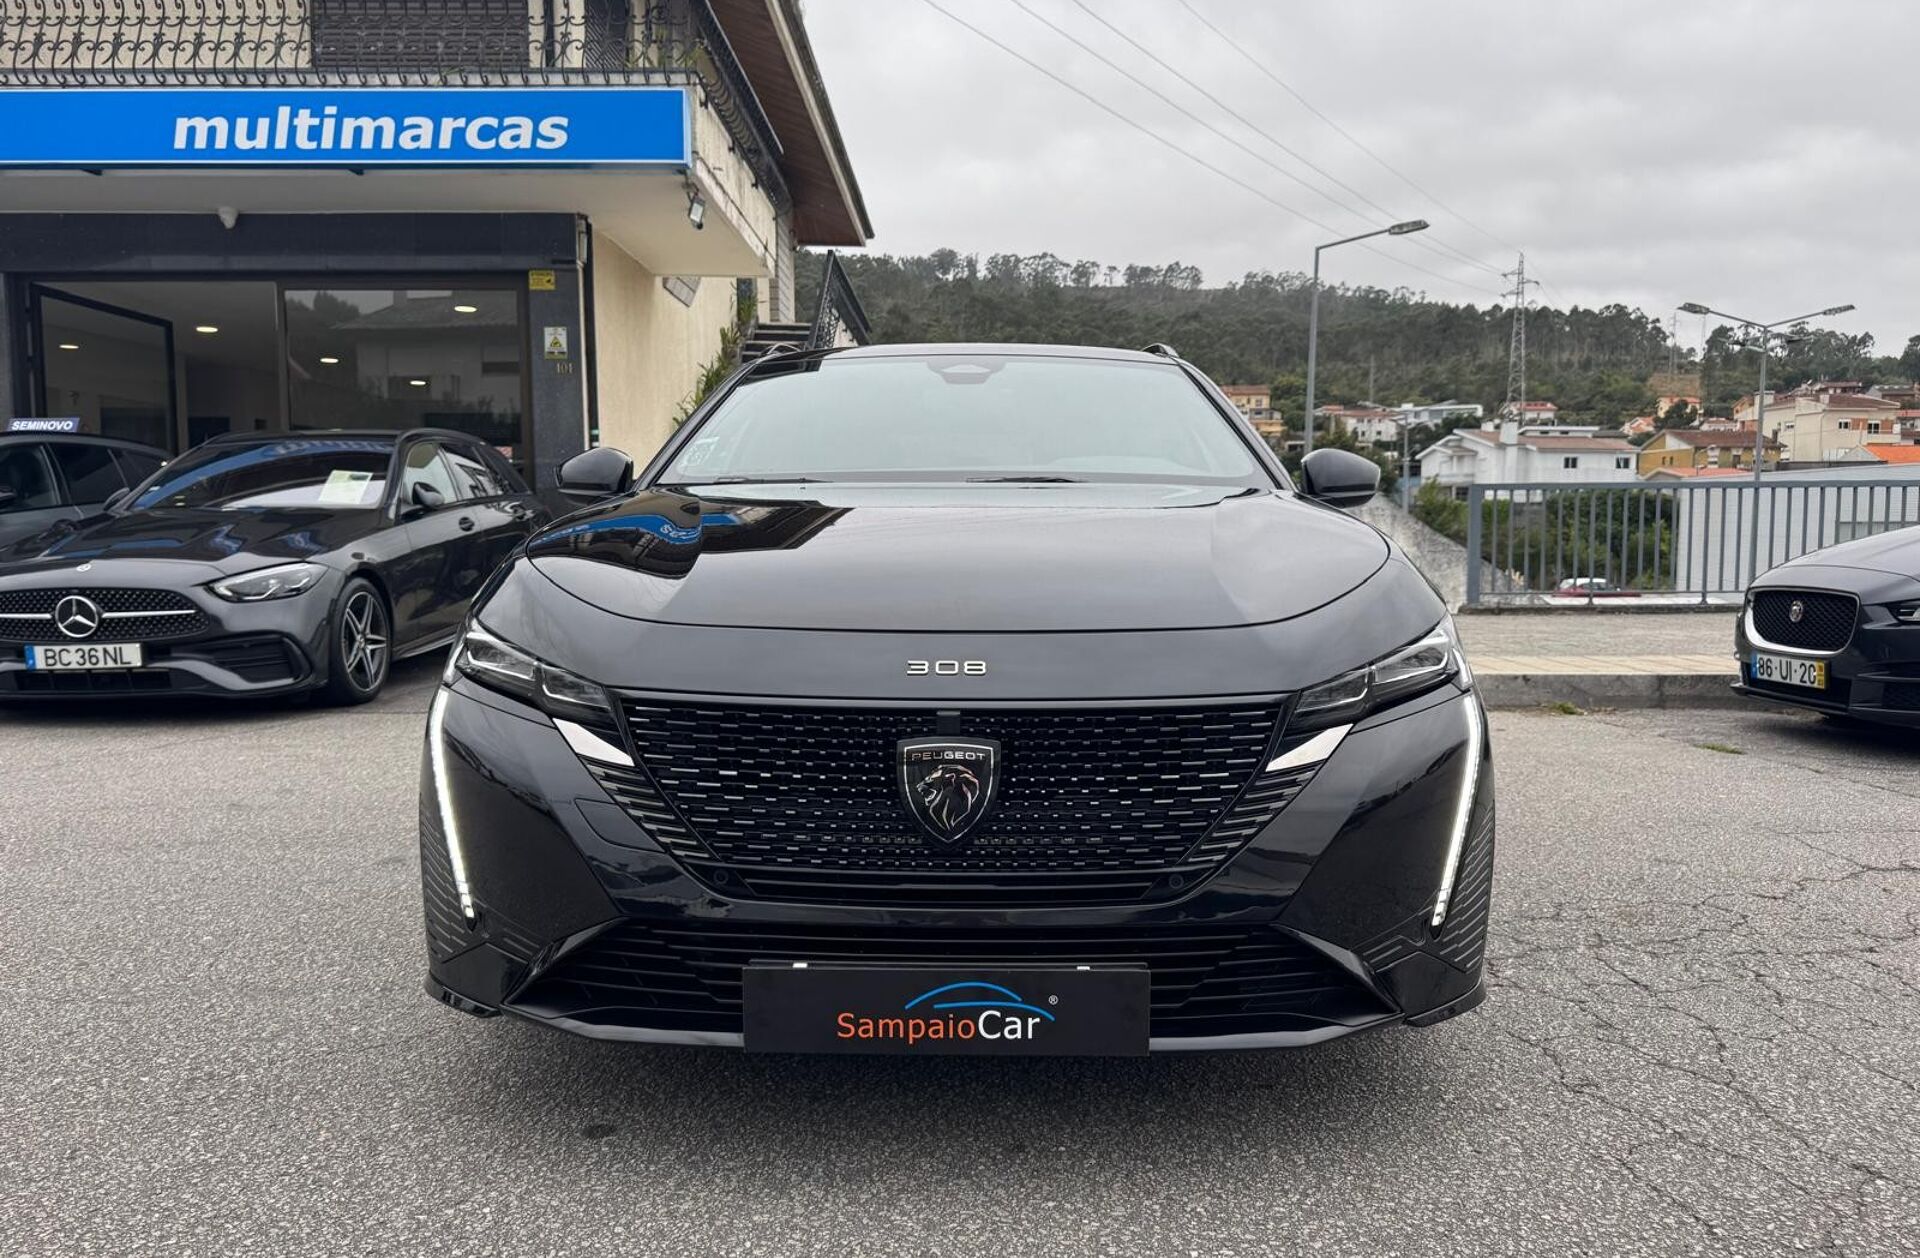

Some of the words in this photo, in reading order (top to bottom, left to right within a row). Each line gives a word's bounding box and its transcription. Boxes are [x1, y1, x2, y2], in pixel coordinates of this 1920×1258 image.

[173, 105, 569, 150] multimarcas
[11, 420, 73, 431] SEMINOVO
[907, 660, 986, 676] 308
[911, 751, 986, 761] PEUGEOT
[836, 1010, 1040, 1045] SampaioCar
